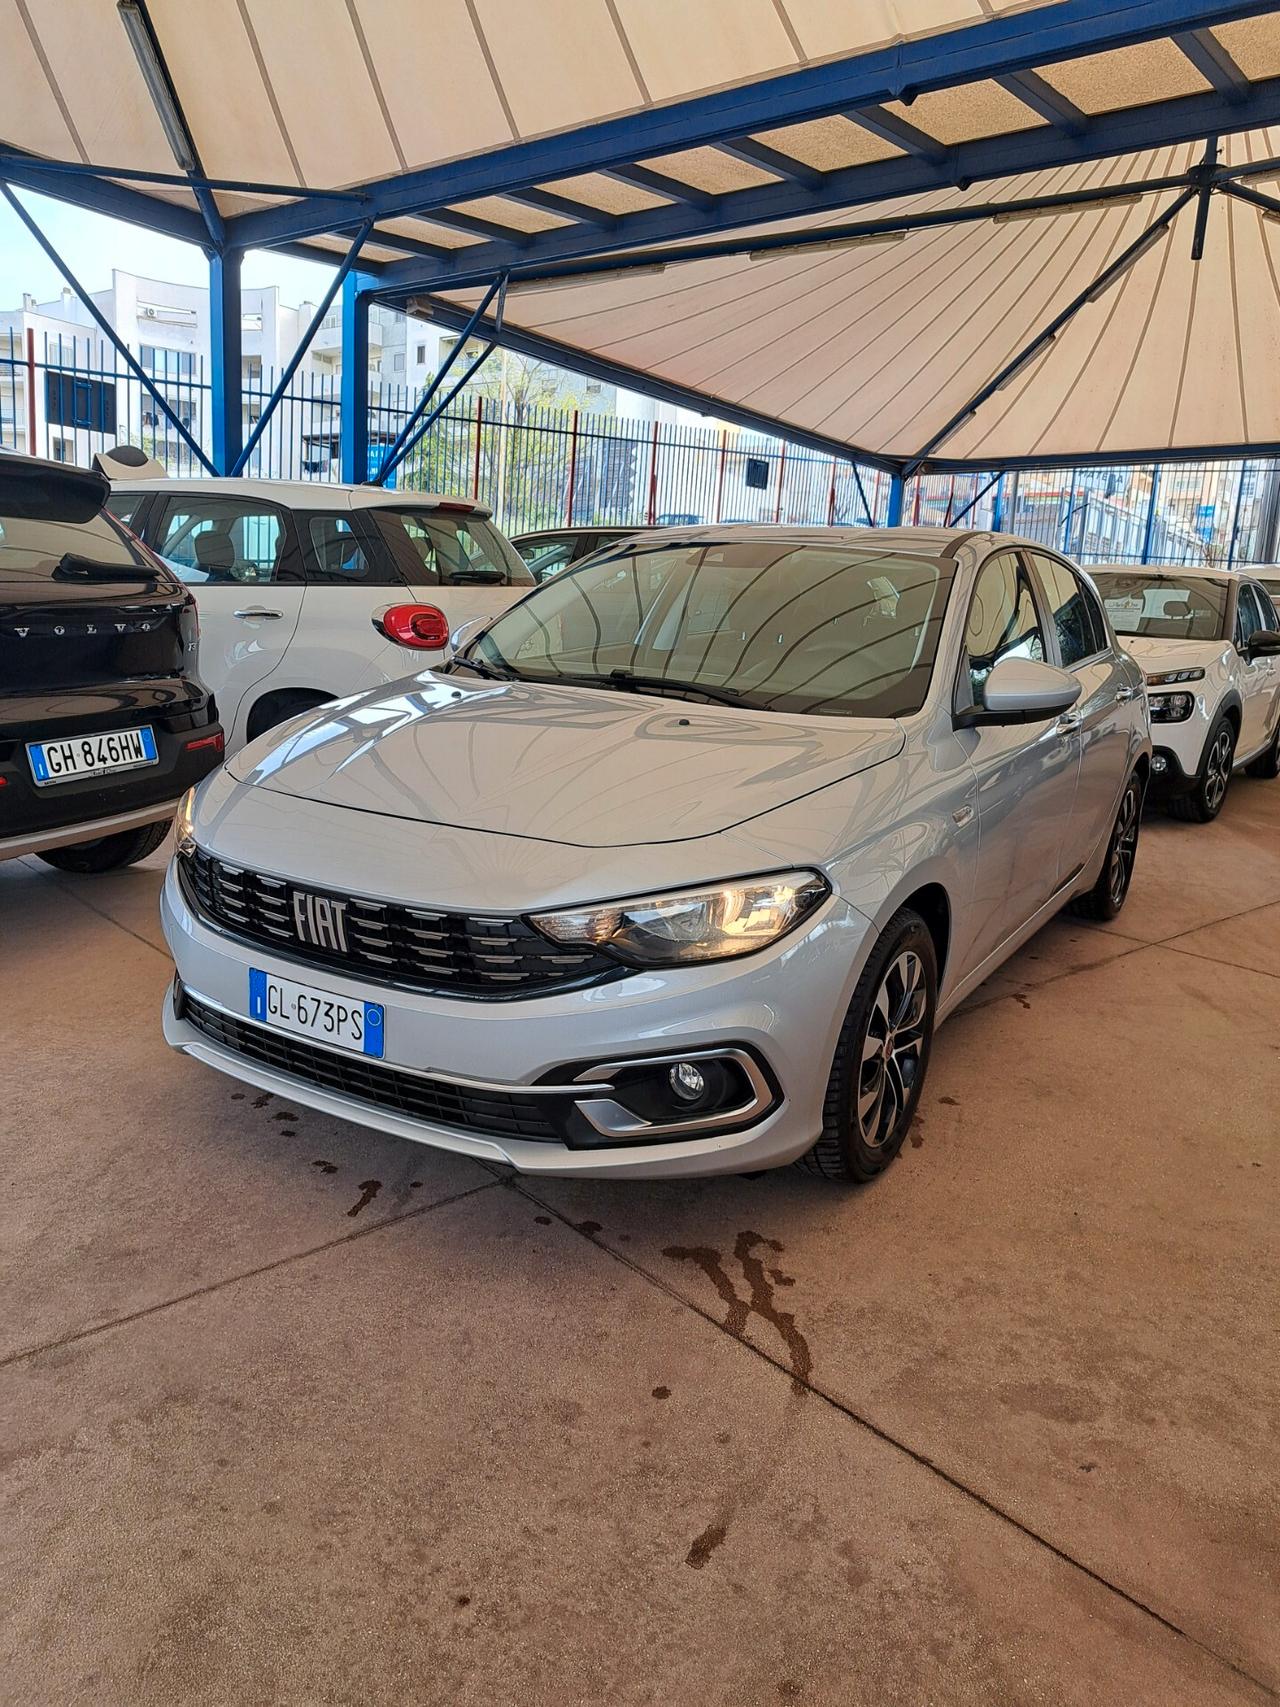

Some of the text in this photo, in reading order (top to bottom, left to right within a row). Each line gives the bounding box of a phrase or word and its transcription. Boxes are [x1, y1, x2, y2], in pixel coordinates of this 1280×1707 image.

[14, 623, 151, 638] VOLVO
[47, 733, 143, 773] GH 846HW
[293, 891, 348, 953] FIAT
[268, 985, 363, 1041] GL 673PS
